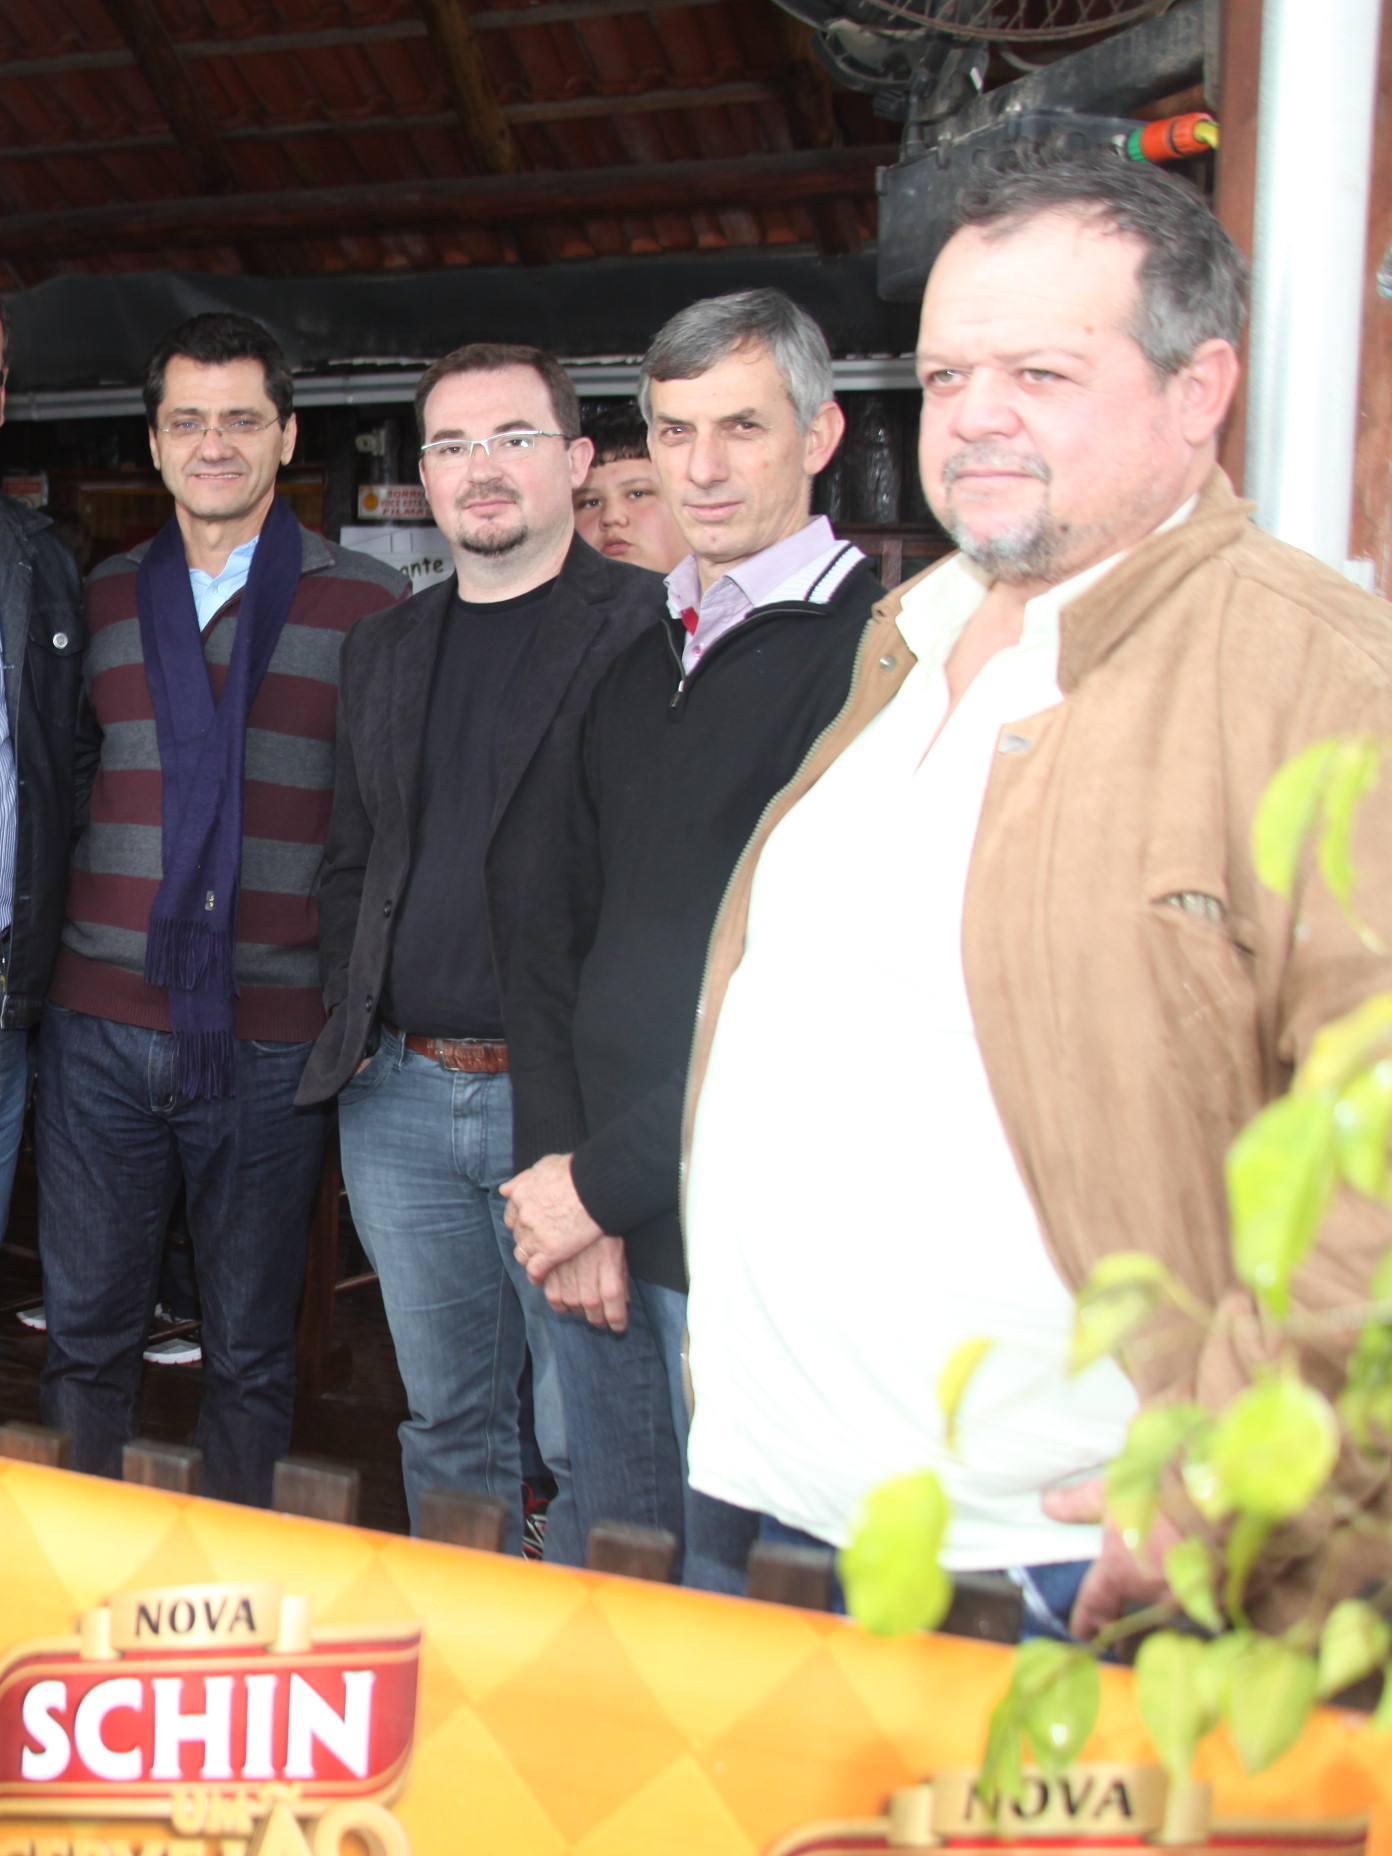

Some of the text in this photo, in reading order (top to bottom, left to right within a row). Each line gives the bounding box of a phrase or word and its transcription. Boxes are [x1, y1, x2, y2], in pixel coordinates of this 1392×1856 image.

[132, 1596, 258, 1640] NOVA
[20, 1669, 377, 1782] SCHIN
[170, 1789, 256, 1836] UM
